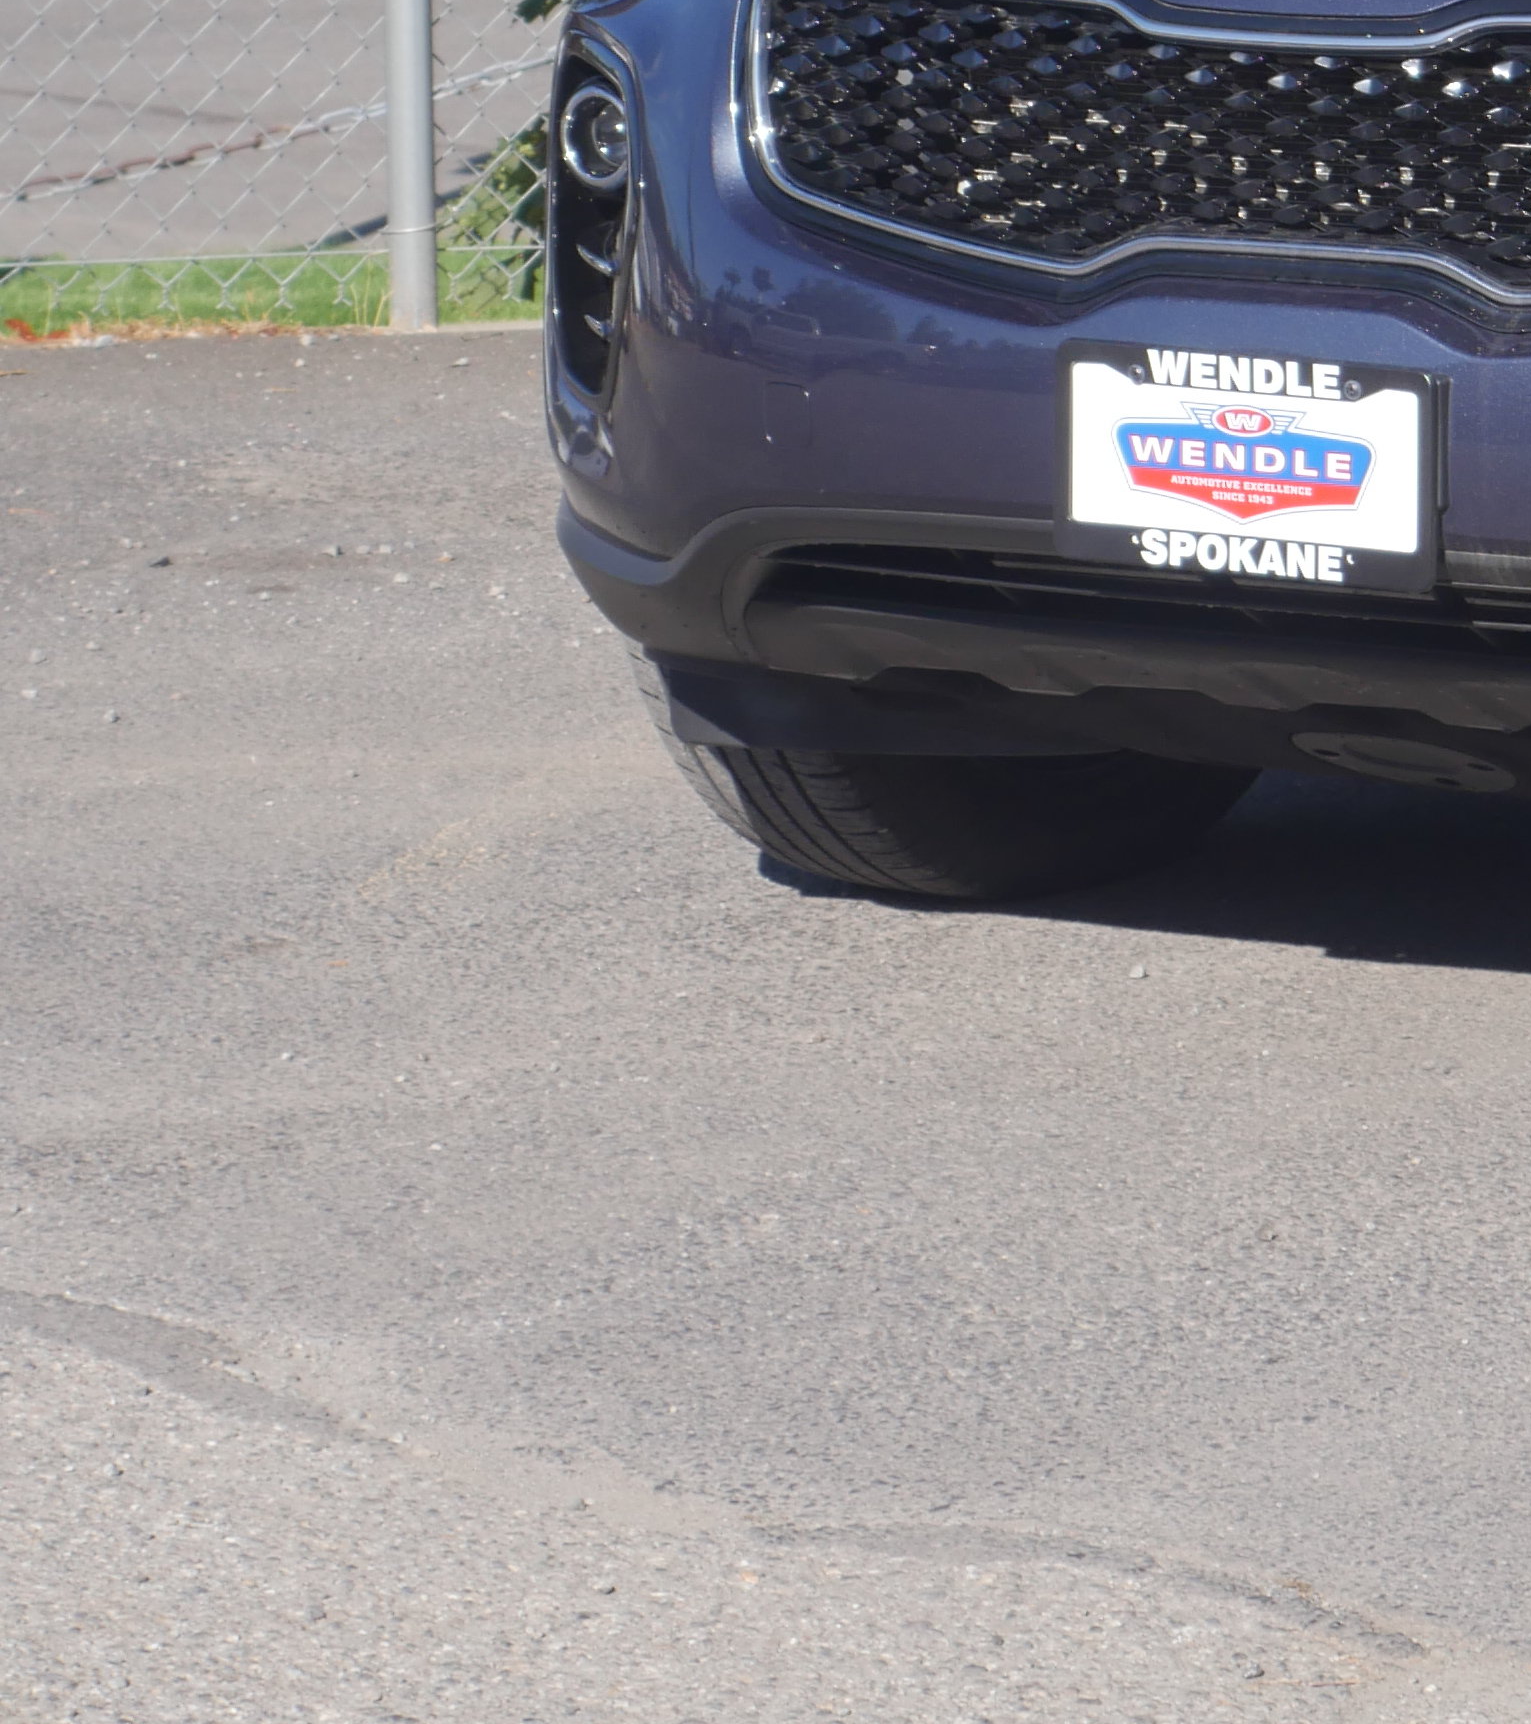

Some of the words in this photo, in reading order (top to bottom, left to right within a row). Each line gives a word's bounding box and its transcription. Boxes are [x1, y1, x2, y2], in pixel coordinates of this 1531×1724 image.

[1146, 347, 1342, 401] WENDLE
[1224, 411, 1261, 432] W
[1129, 433, 1353, 481] WENDLE
[1170, 474, 1241, 490] AUTOMOTIVE
[1242, 481, 1313, 496] EXCELLENCE
[1211, 491, 1246, 503] SINCE
[1139, 528, 1344, 583] SPOKANE
